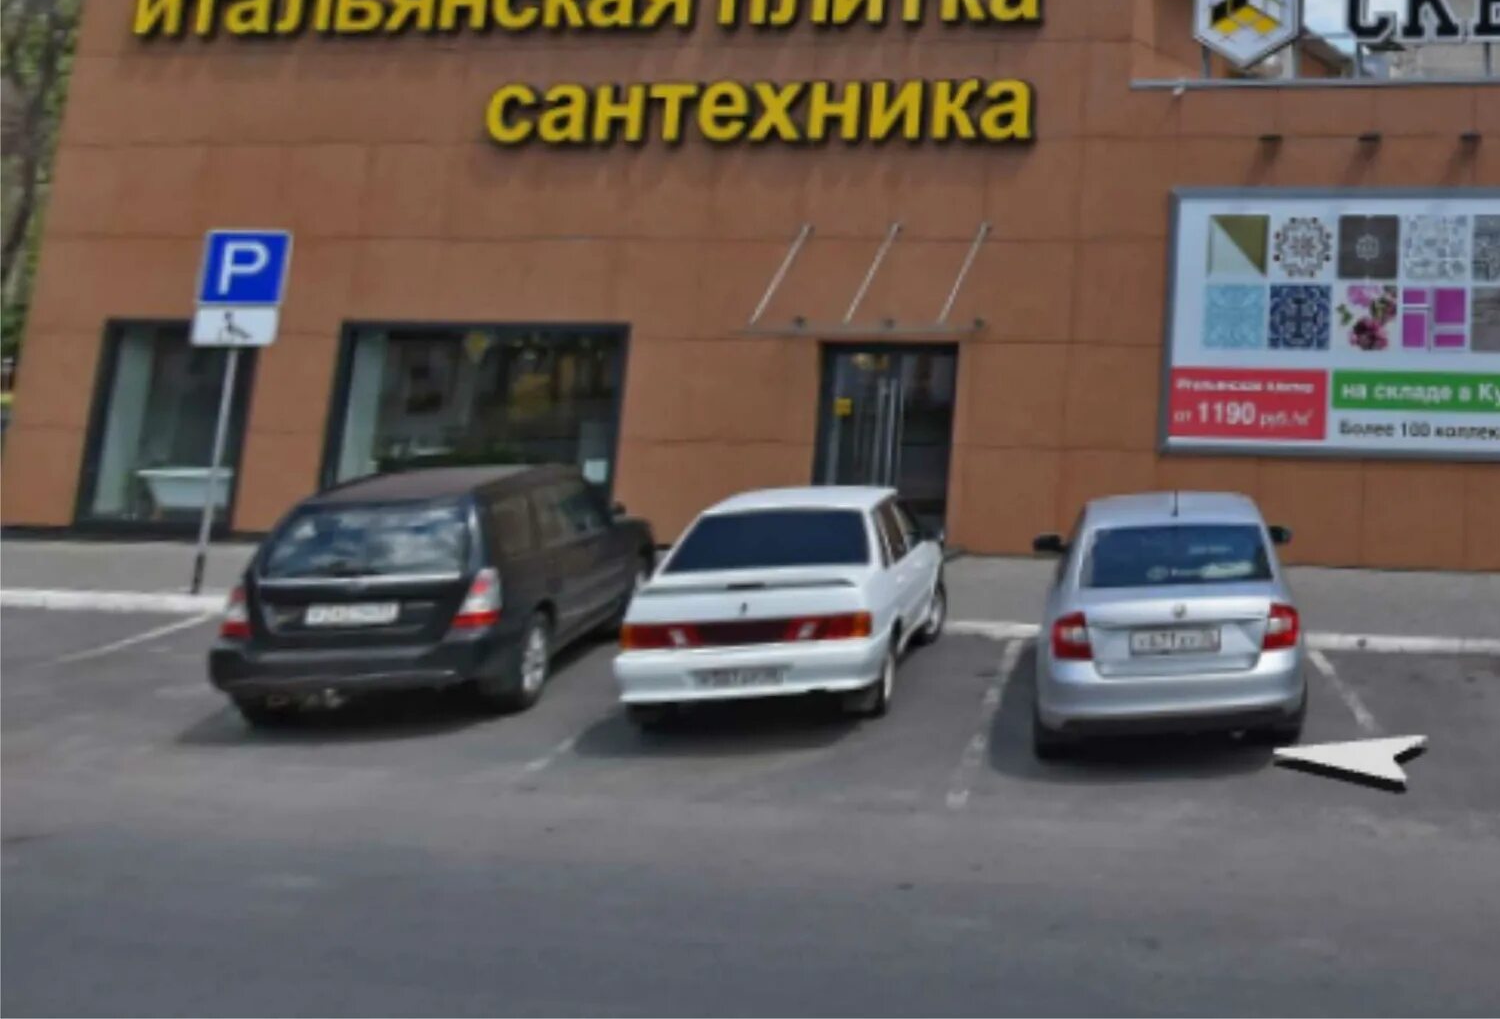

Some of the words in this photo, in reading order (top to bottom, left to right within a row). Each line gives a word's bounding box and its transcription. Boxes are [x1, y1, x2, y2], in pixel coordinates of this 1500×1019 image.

[484, 77, 1033, 145] сантехника
[1341, 383, 1367, 399] на
[1197, 401, 1256, 425] 1190
[1338, 418, 1395, 437] Более
[1400, 421, 1431, 438] 100
